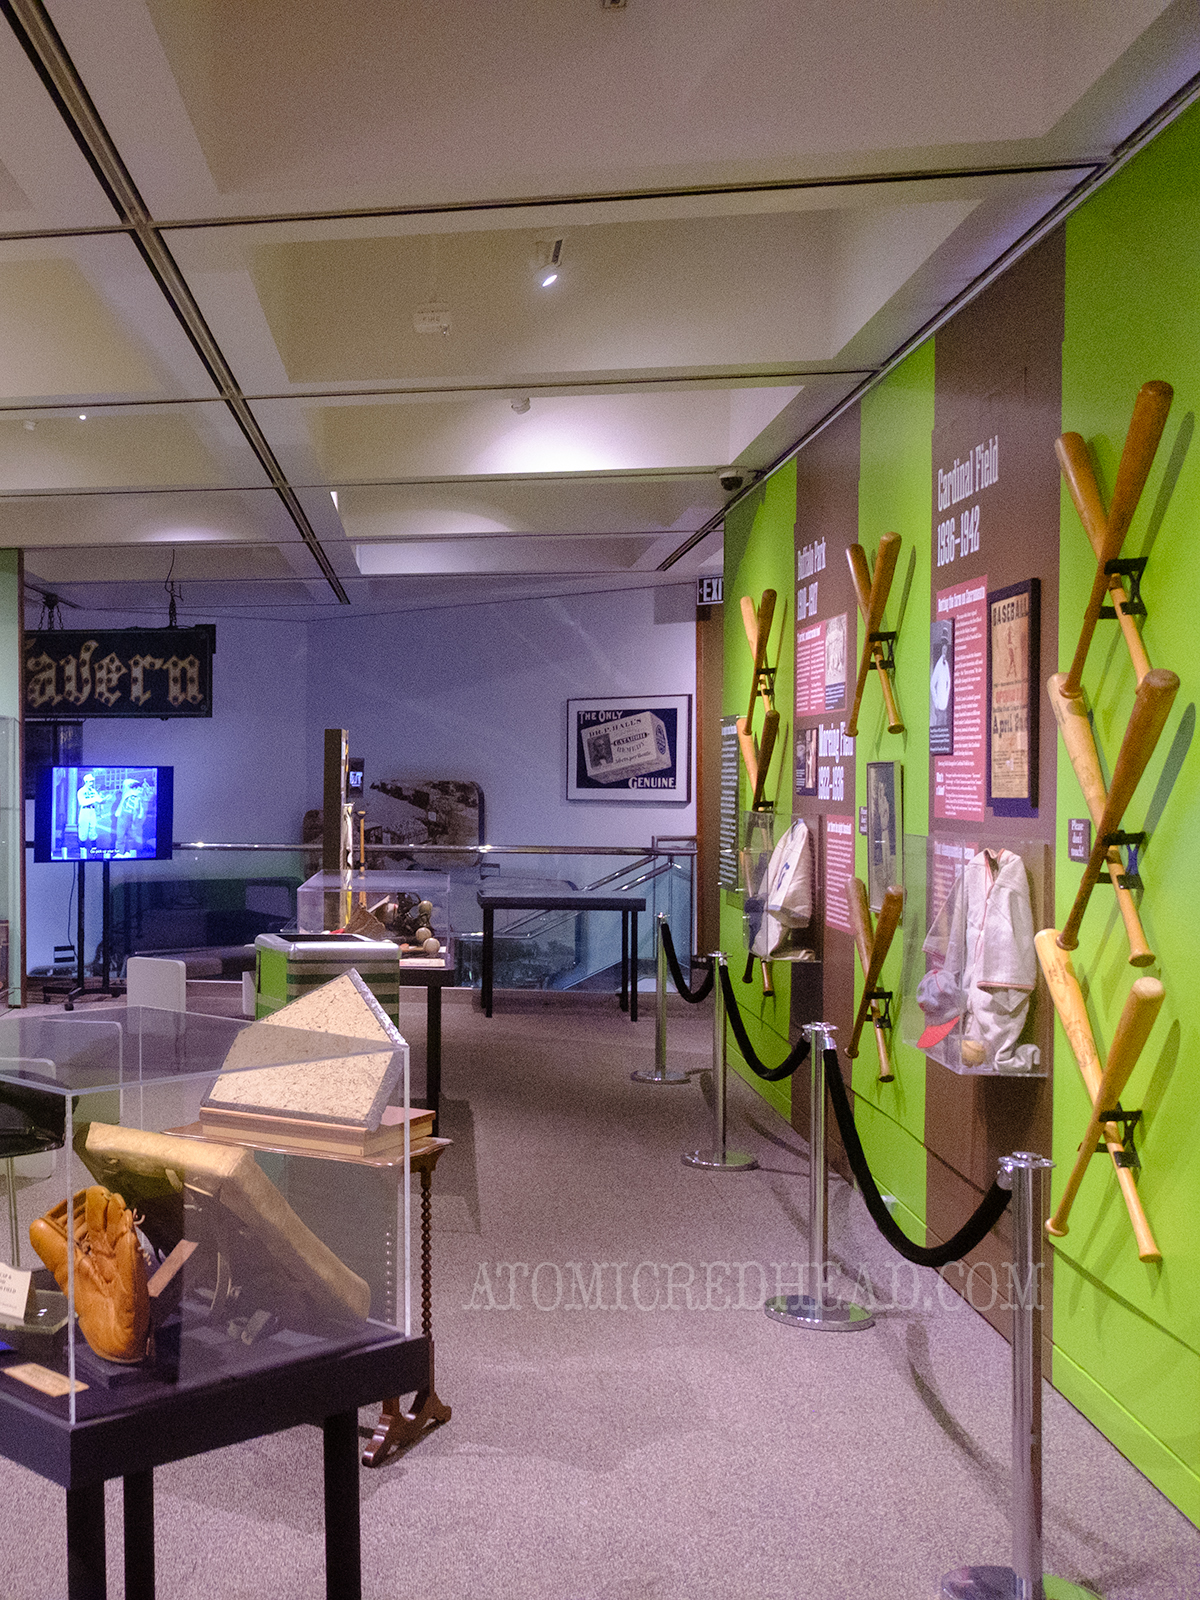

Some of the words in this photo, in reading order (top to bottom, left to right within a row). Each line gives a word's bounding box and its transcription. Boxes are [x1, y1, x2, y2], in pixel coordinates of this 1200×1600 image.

[937, 450, 974, 512] Cardinal
[975, 435, 999, 492] Field
[703, 578, 723, 601] EXI
[25, 640, 204, 708] avern
[579, 711, 597, 725] THE
[599, 711, 623, 723] ONLY
[613, 719, 641, 731] HALL'S
[628, 777, 677, 789] GENUINE.
